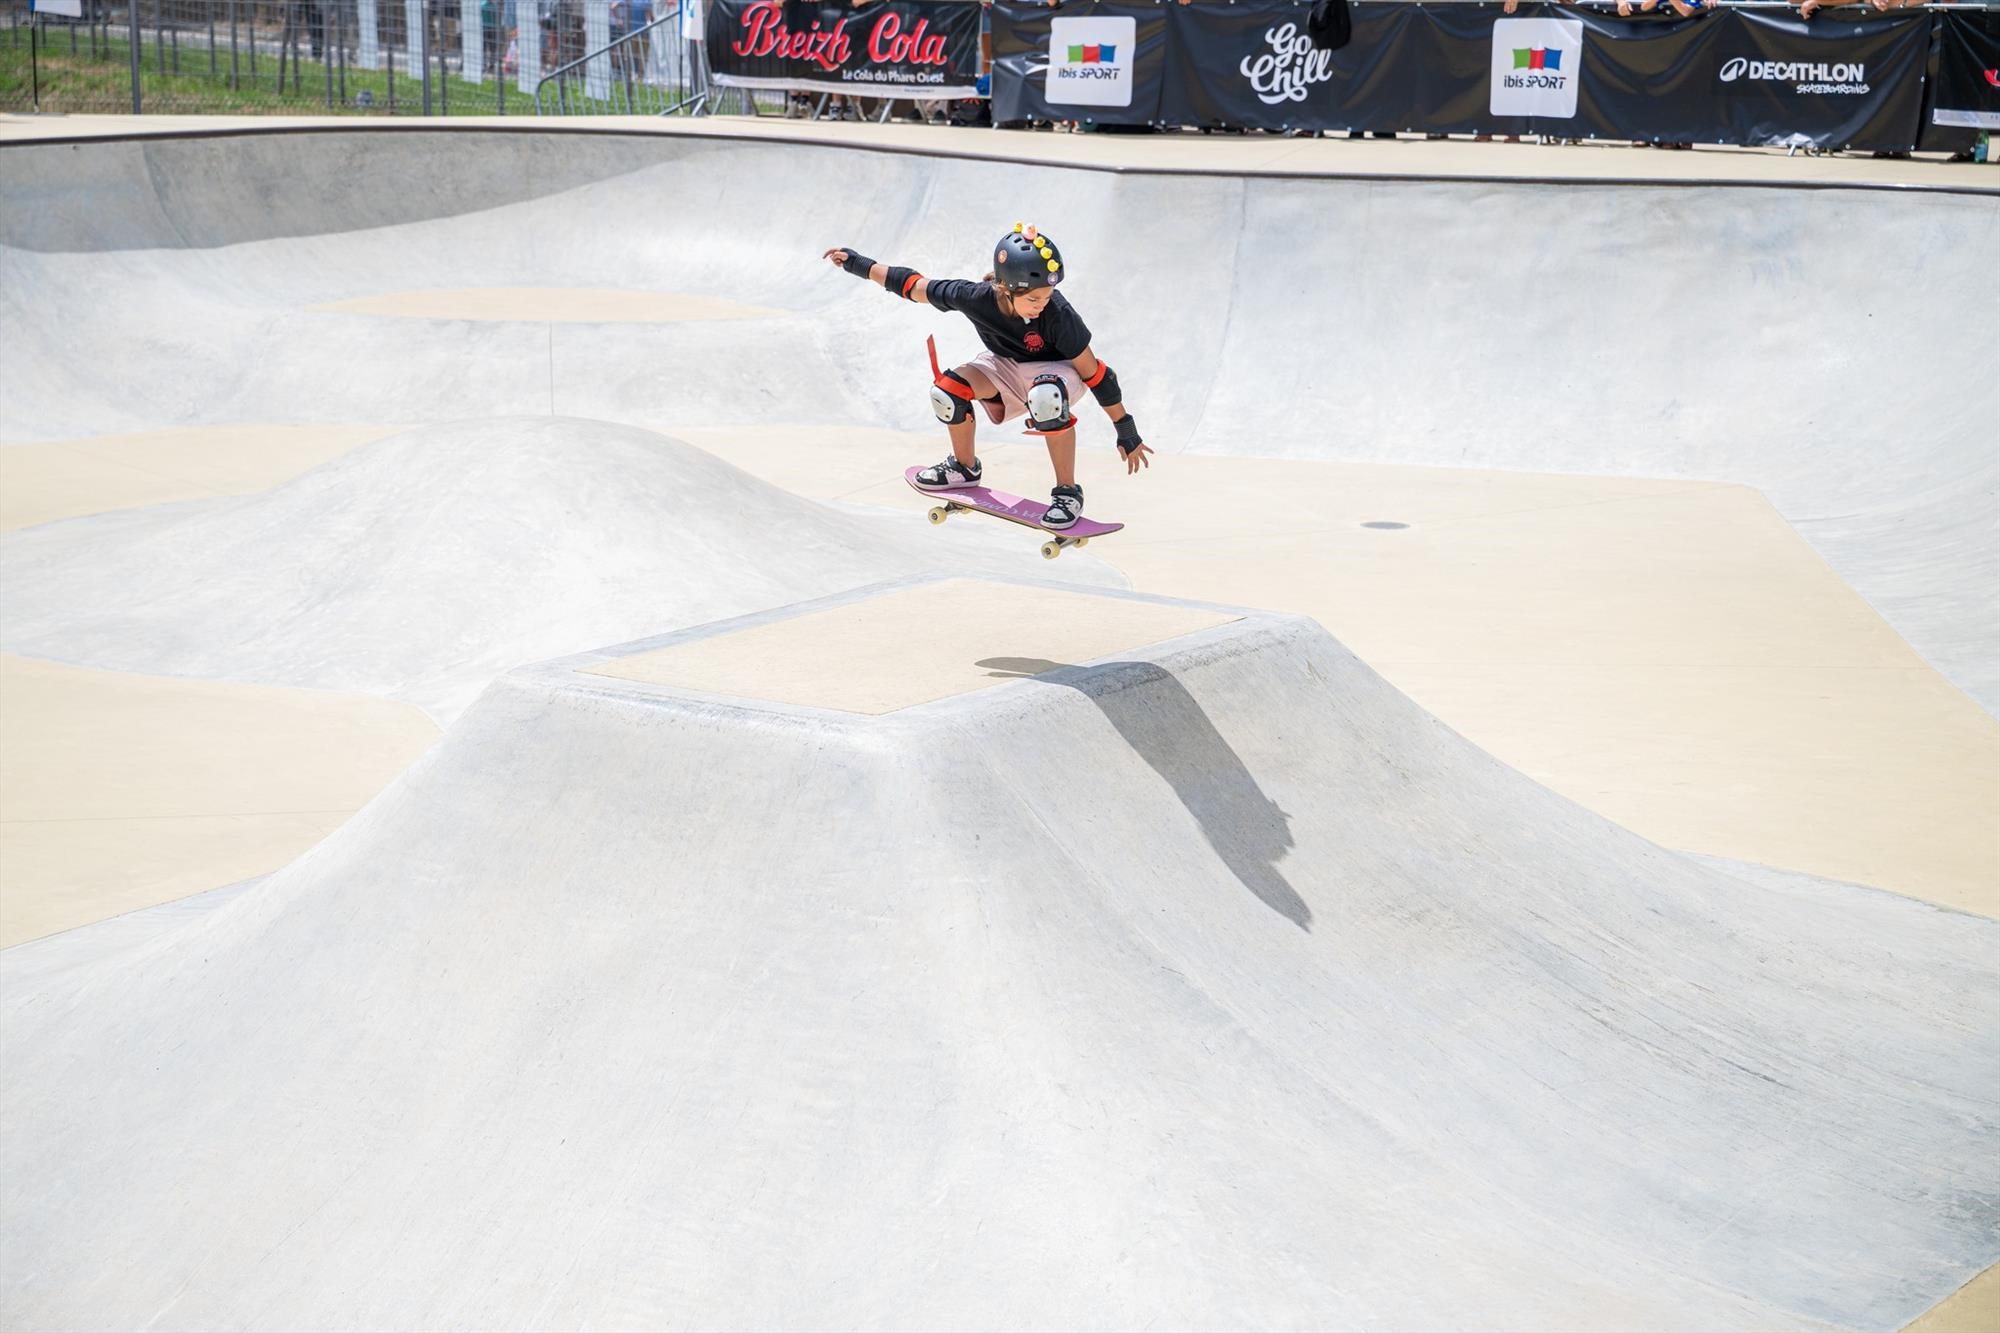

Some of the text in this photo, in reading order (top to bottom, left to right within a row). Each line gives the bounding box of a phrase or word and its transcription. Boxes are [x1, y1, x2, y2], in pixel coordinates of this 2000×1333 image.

[732, 1, 948, 71] Breizh Cola
[1265, 22, 1312, 68] Go
[842, 69, 853, 80] Le
[853, 69, 873, 81] Cola
[874, 69, 887, 82] du
[888, 70, 915, 83] Phare
[1058, 67, 1120, 80] ibis SPORT
[1240, 48, 1333, 104] Chill
[1503, 75, 1567, 89] ibis SPORT
[1748, 61, 1864, 82] DECATHLON
